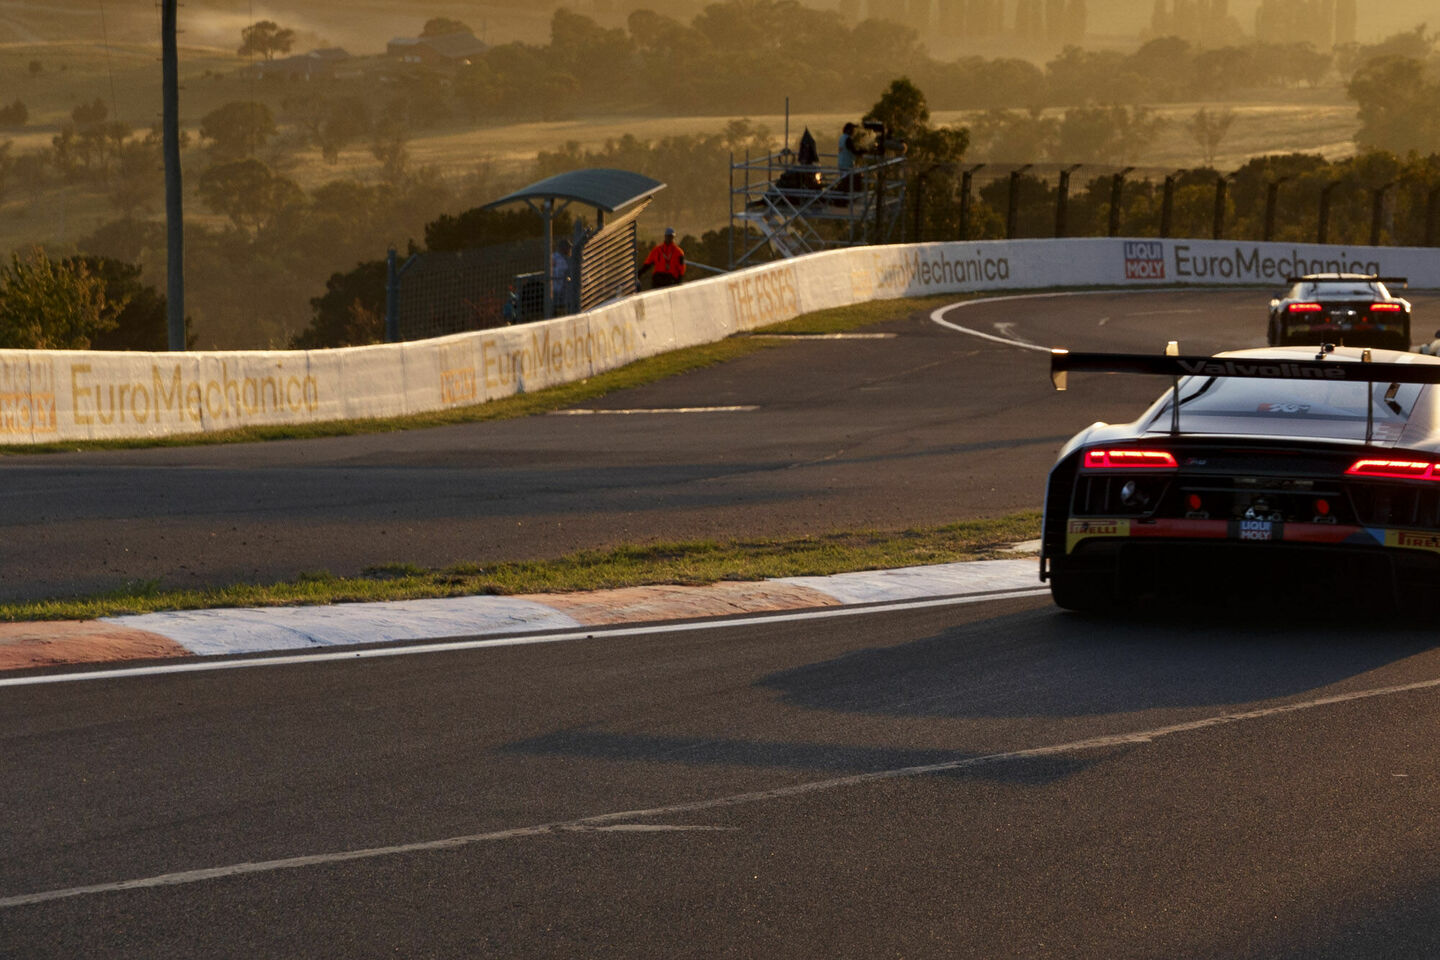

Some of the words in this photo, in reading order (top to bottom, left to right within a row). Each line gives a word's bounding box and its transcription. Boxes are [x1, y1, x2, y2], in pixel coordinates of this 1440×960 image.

[1127, 244, 1163, 258] LIQUI
[872, 250, 1010, 288] EuroMechanica
[1126, 261, 1164, 278] MOLY
[1174, 246, 1380, 278] EuroMechanica
[483, 317, 634, 388] EuroMechanica
[1178, 359, 1346, 379] Valvoline
[71, 362, 318, 425] EuroMechanica
[1241, 521, 1272, 530] LIQUI
[1241, 531, 1272, 540] MOLY
